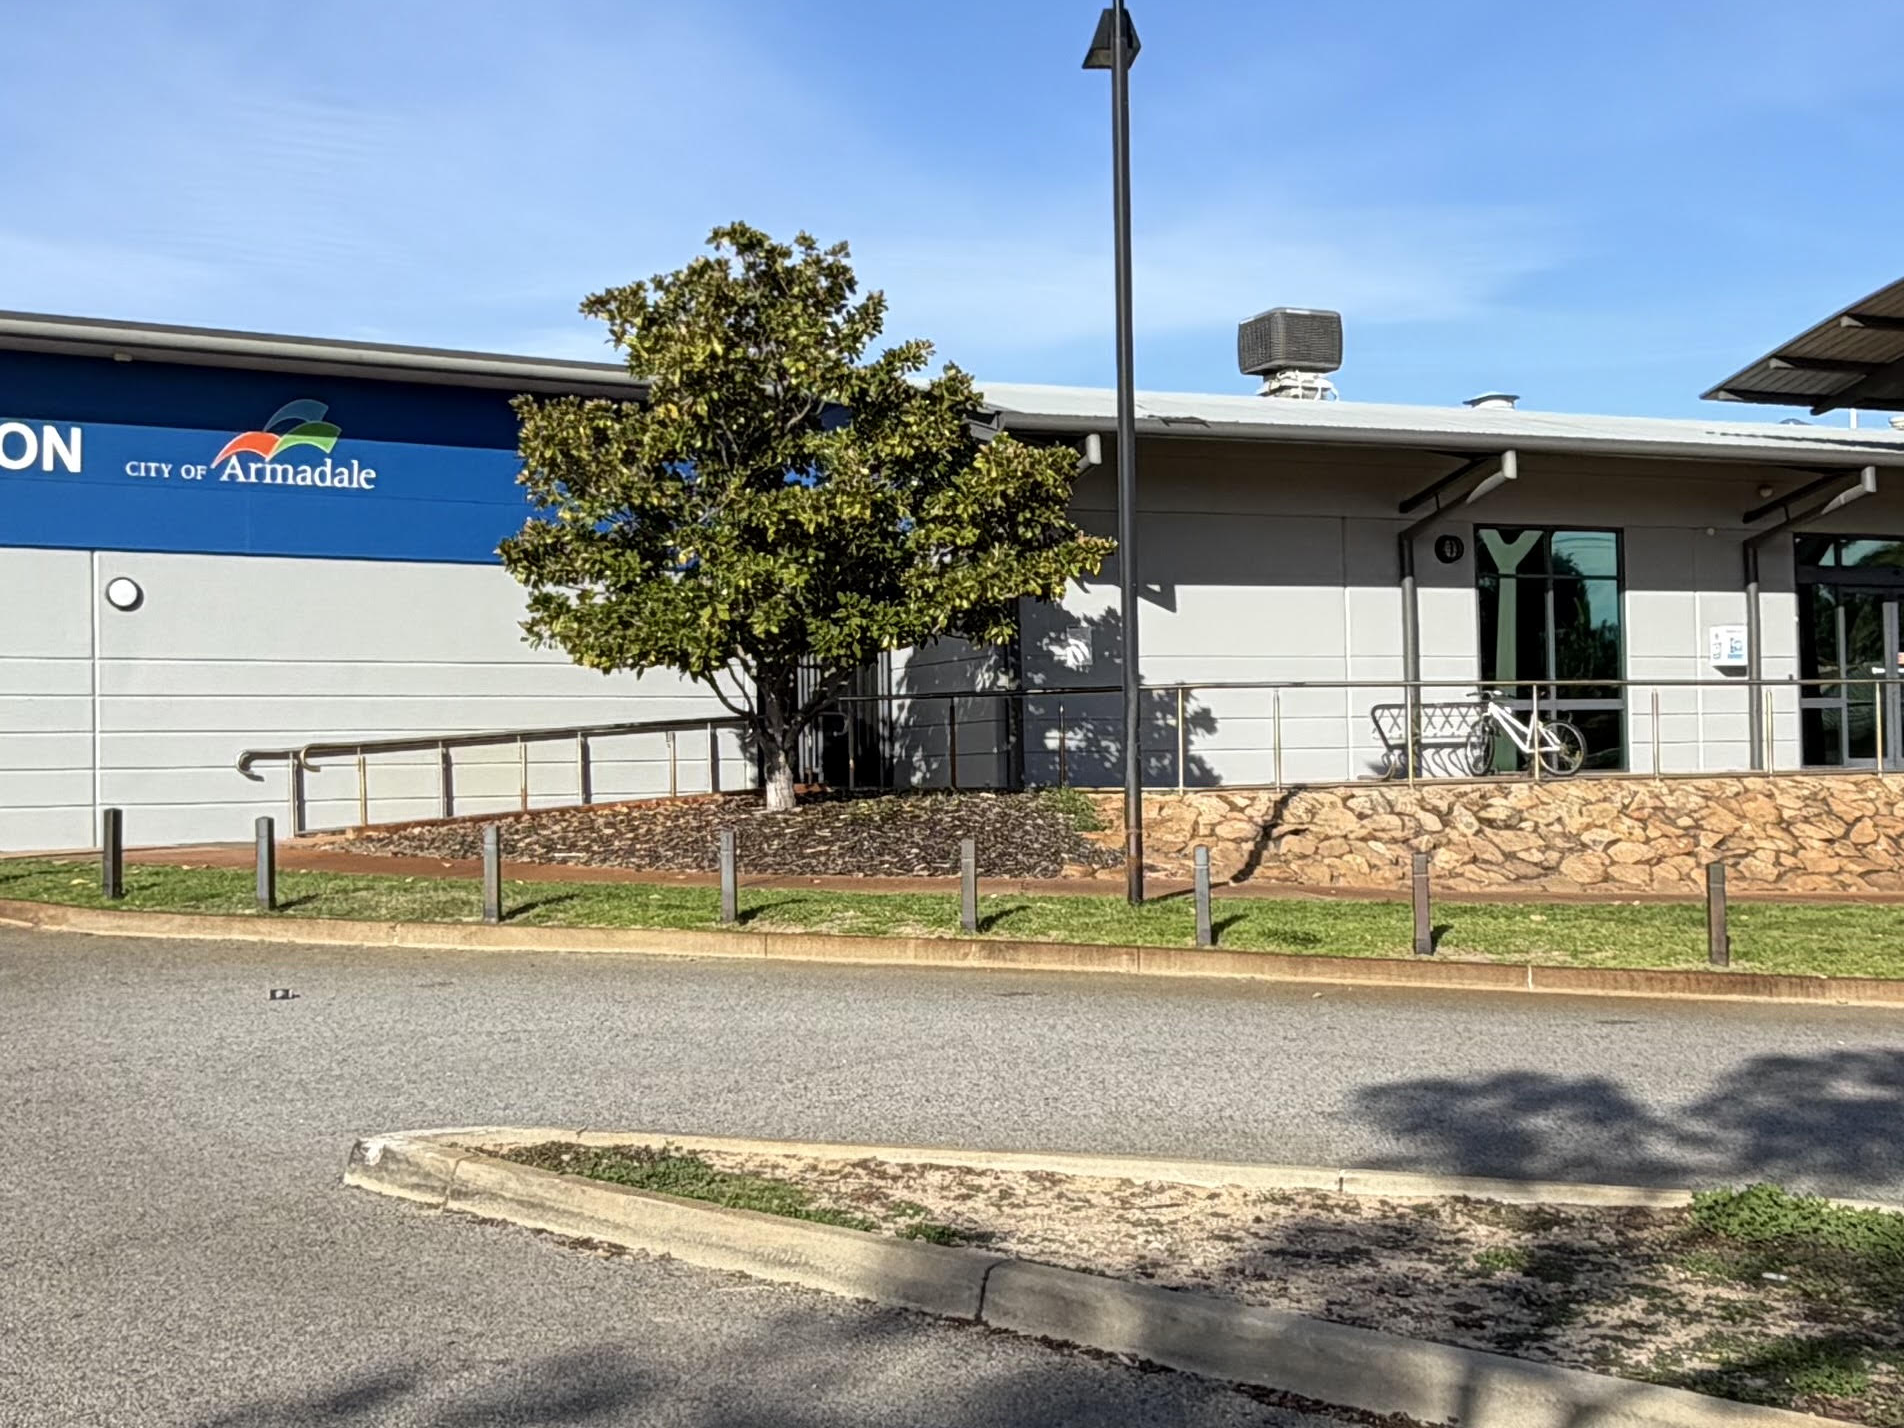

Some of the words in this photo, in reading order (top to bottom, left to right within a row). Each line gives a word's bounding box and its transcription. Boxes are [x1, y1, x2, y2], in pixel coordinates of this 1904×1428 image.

[125, 460, 173, 478] CITY
[180, 464, 207, 480] OF
[219, 455, 377, 489] Armadale
